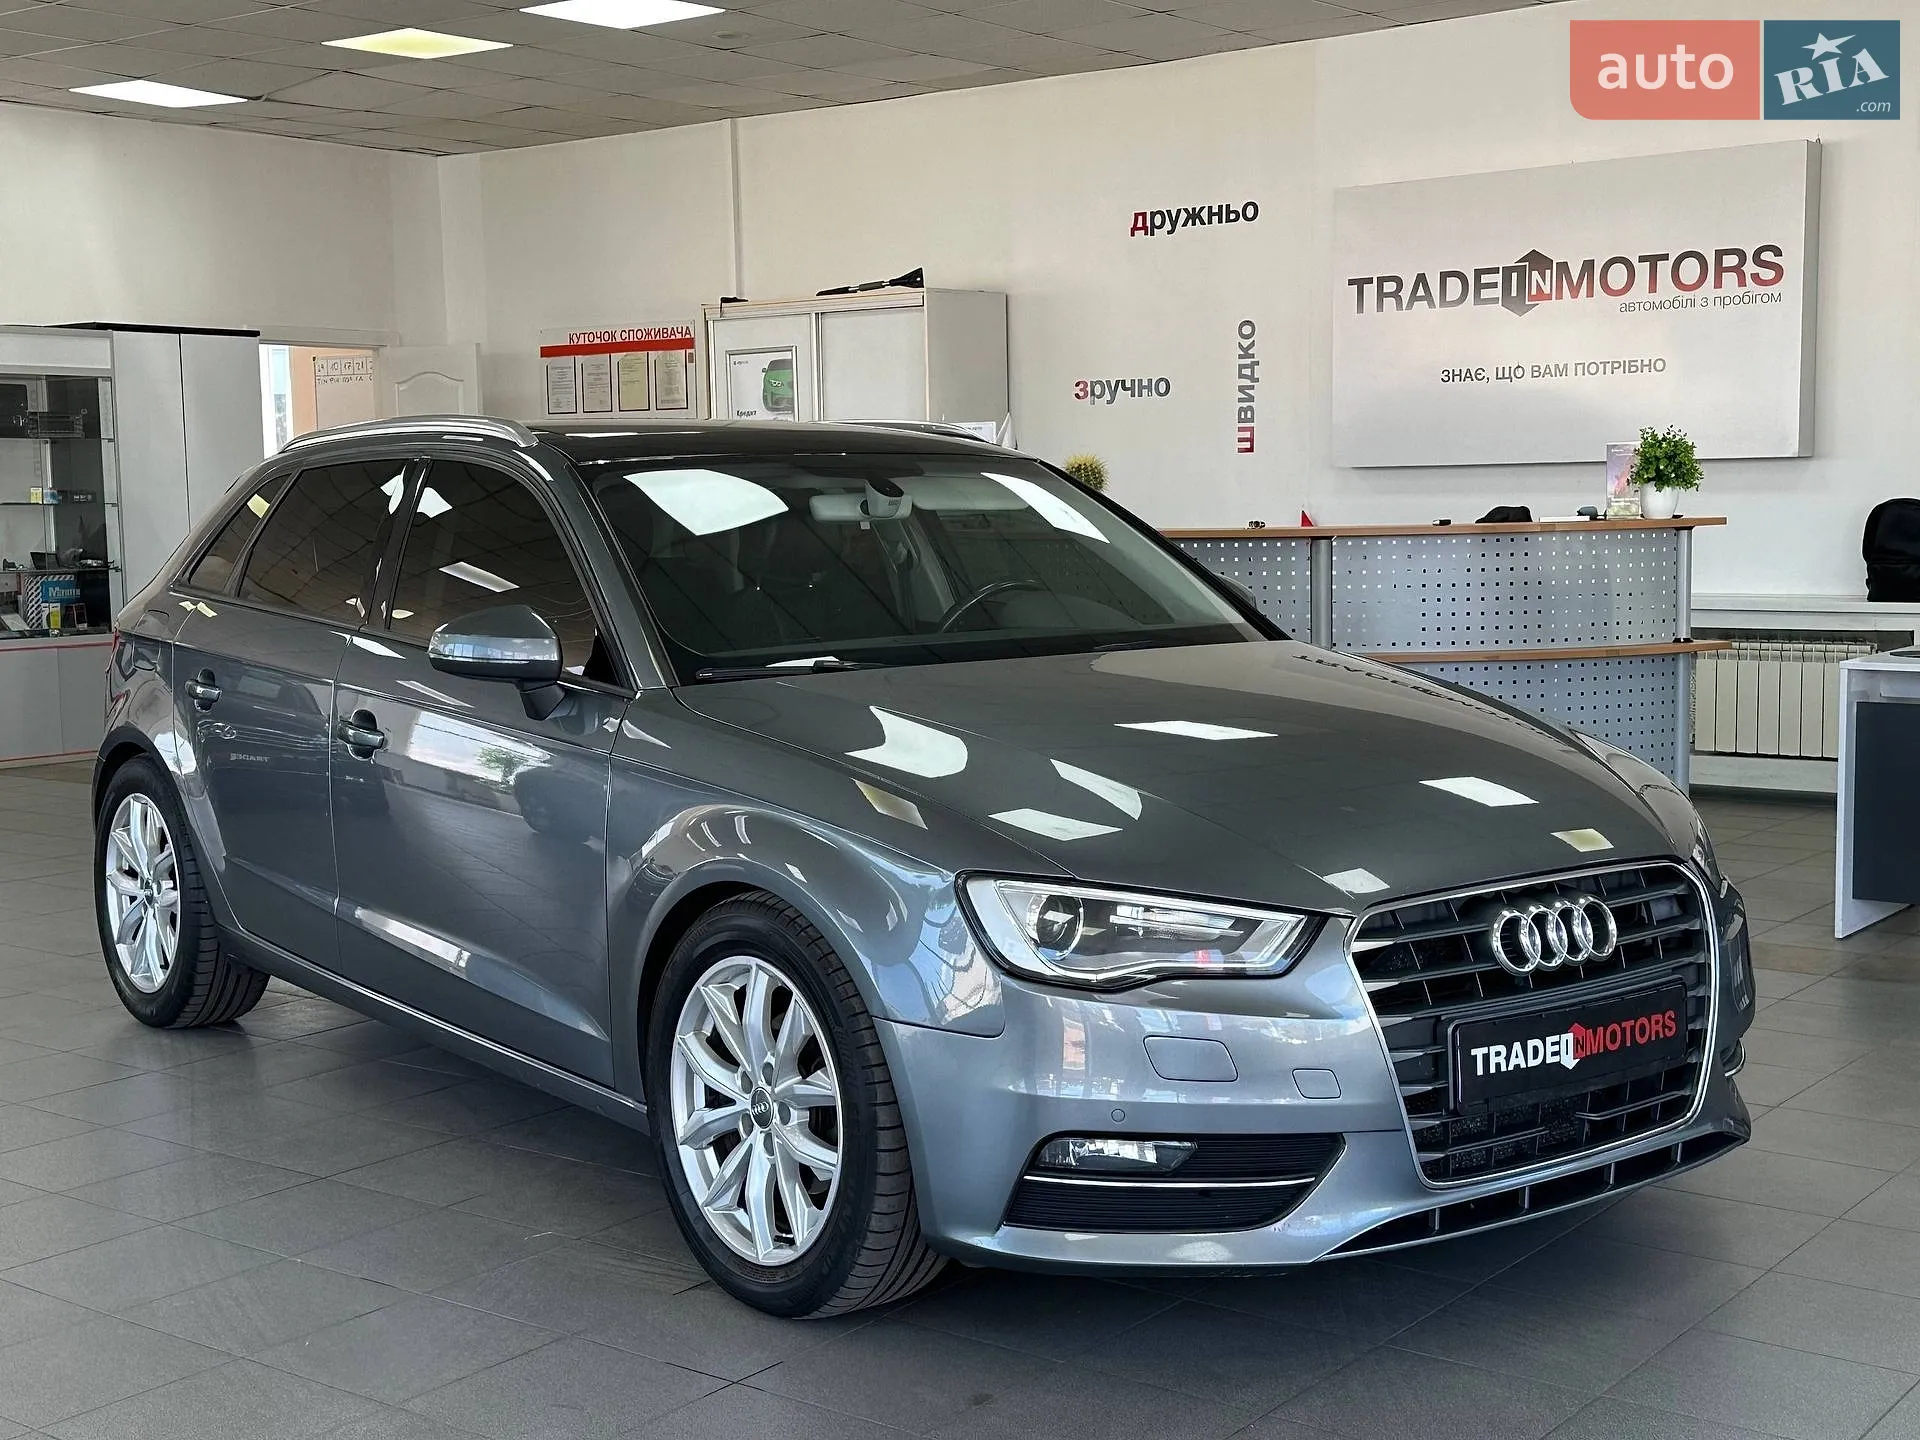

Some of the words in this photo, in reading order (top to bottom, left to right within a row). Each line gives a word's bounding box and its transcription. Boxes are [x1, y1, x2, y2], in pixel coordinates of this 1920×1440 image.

[1129, 200, 1260, 237] дружньо
[1619, 294, 1697, 313] автомобілі
[1700, 296, 1709, 308] з
[1713, 290, 1783, 310] пробігом
[569, 330, 618, 345] КУТОЧОК
[620, 326, 693, 341] СПОЖИВАЧА
[1440, 367, 1490, 384] ЗНАЄ,
[1495, 363, 1526, 383] ЩО
[1530, 362, 1569, 379] ВАМ
[1574, 357, 1667, 377] ПОТРІБНО
[1073, 376, 1171, 405] зручно
[1237, 319, 1260, 454] швидко
